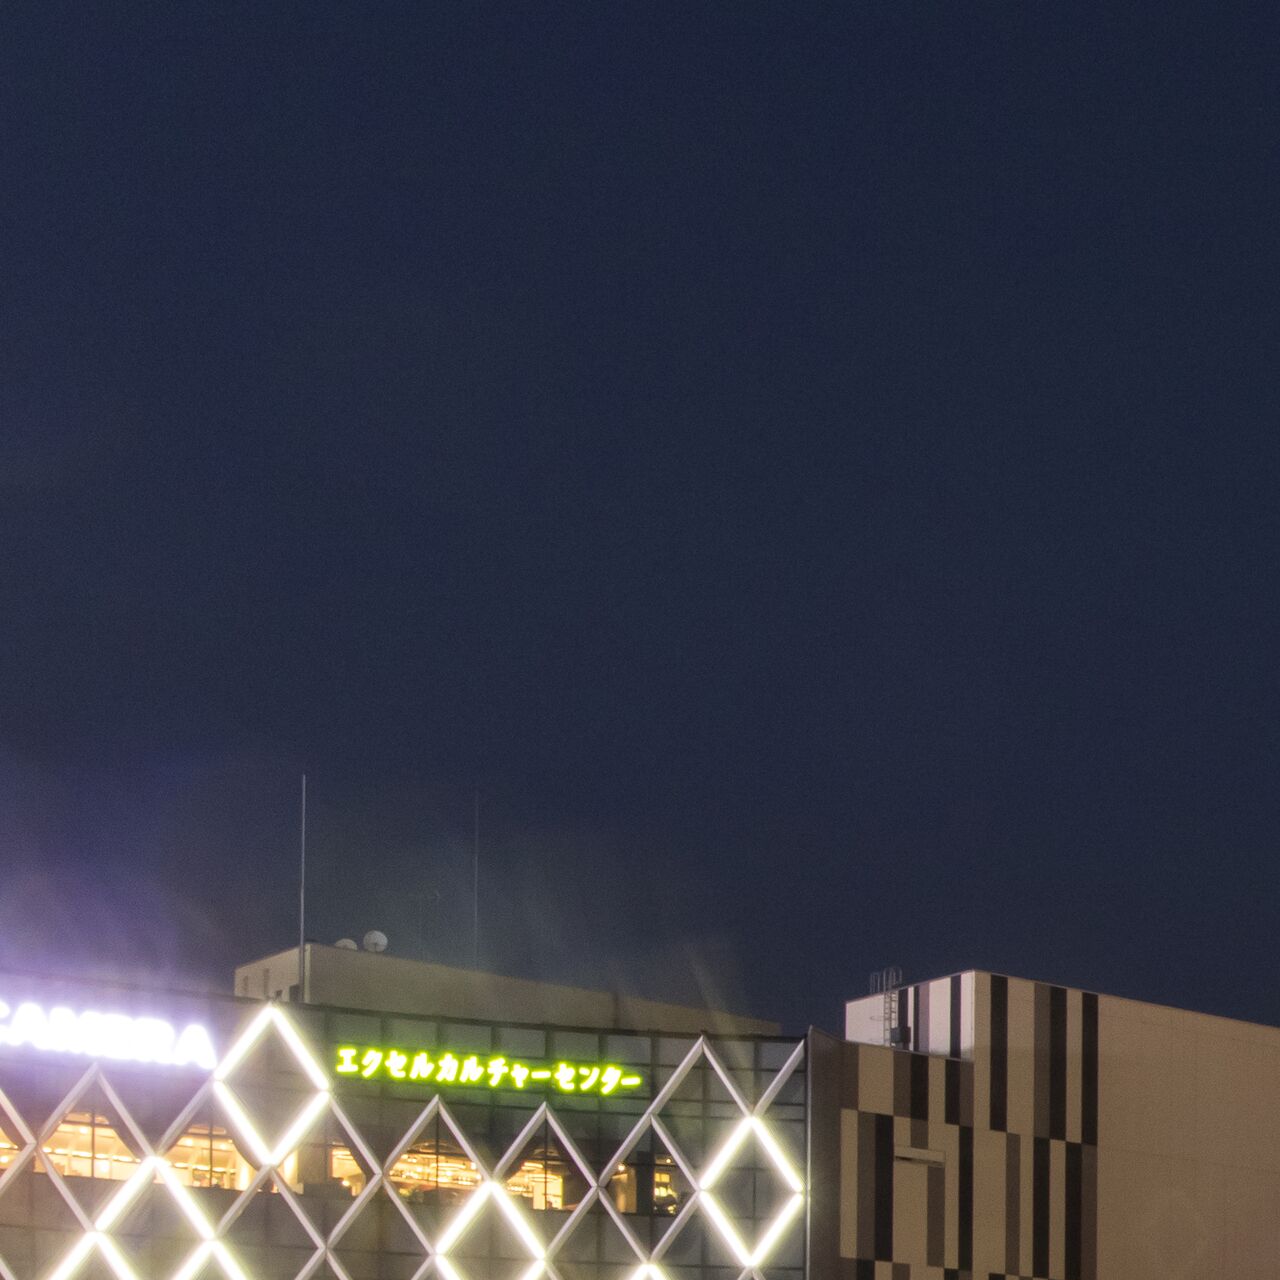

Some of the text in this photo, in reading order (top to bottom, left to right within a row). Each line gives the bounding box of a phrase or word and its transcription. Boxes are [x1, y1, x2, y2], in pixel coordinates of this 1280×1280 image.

[336, 1048, 641, 1094] エクセルカルチャーセンター
